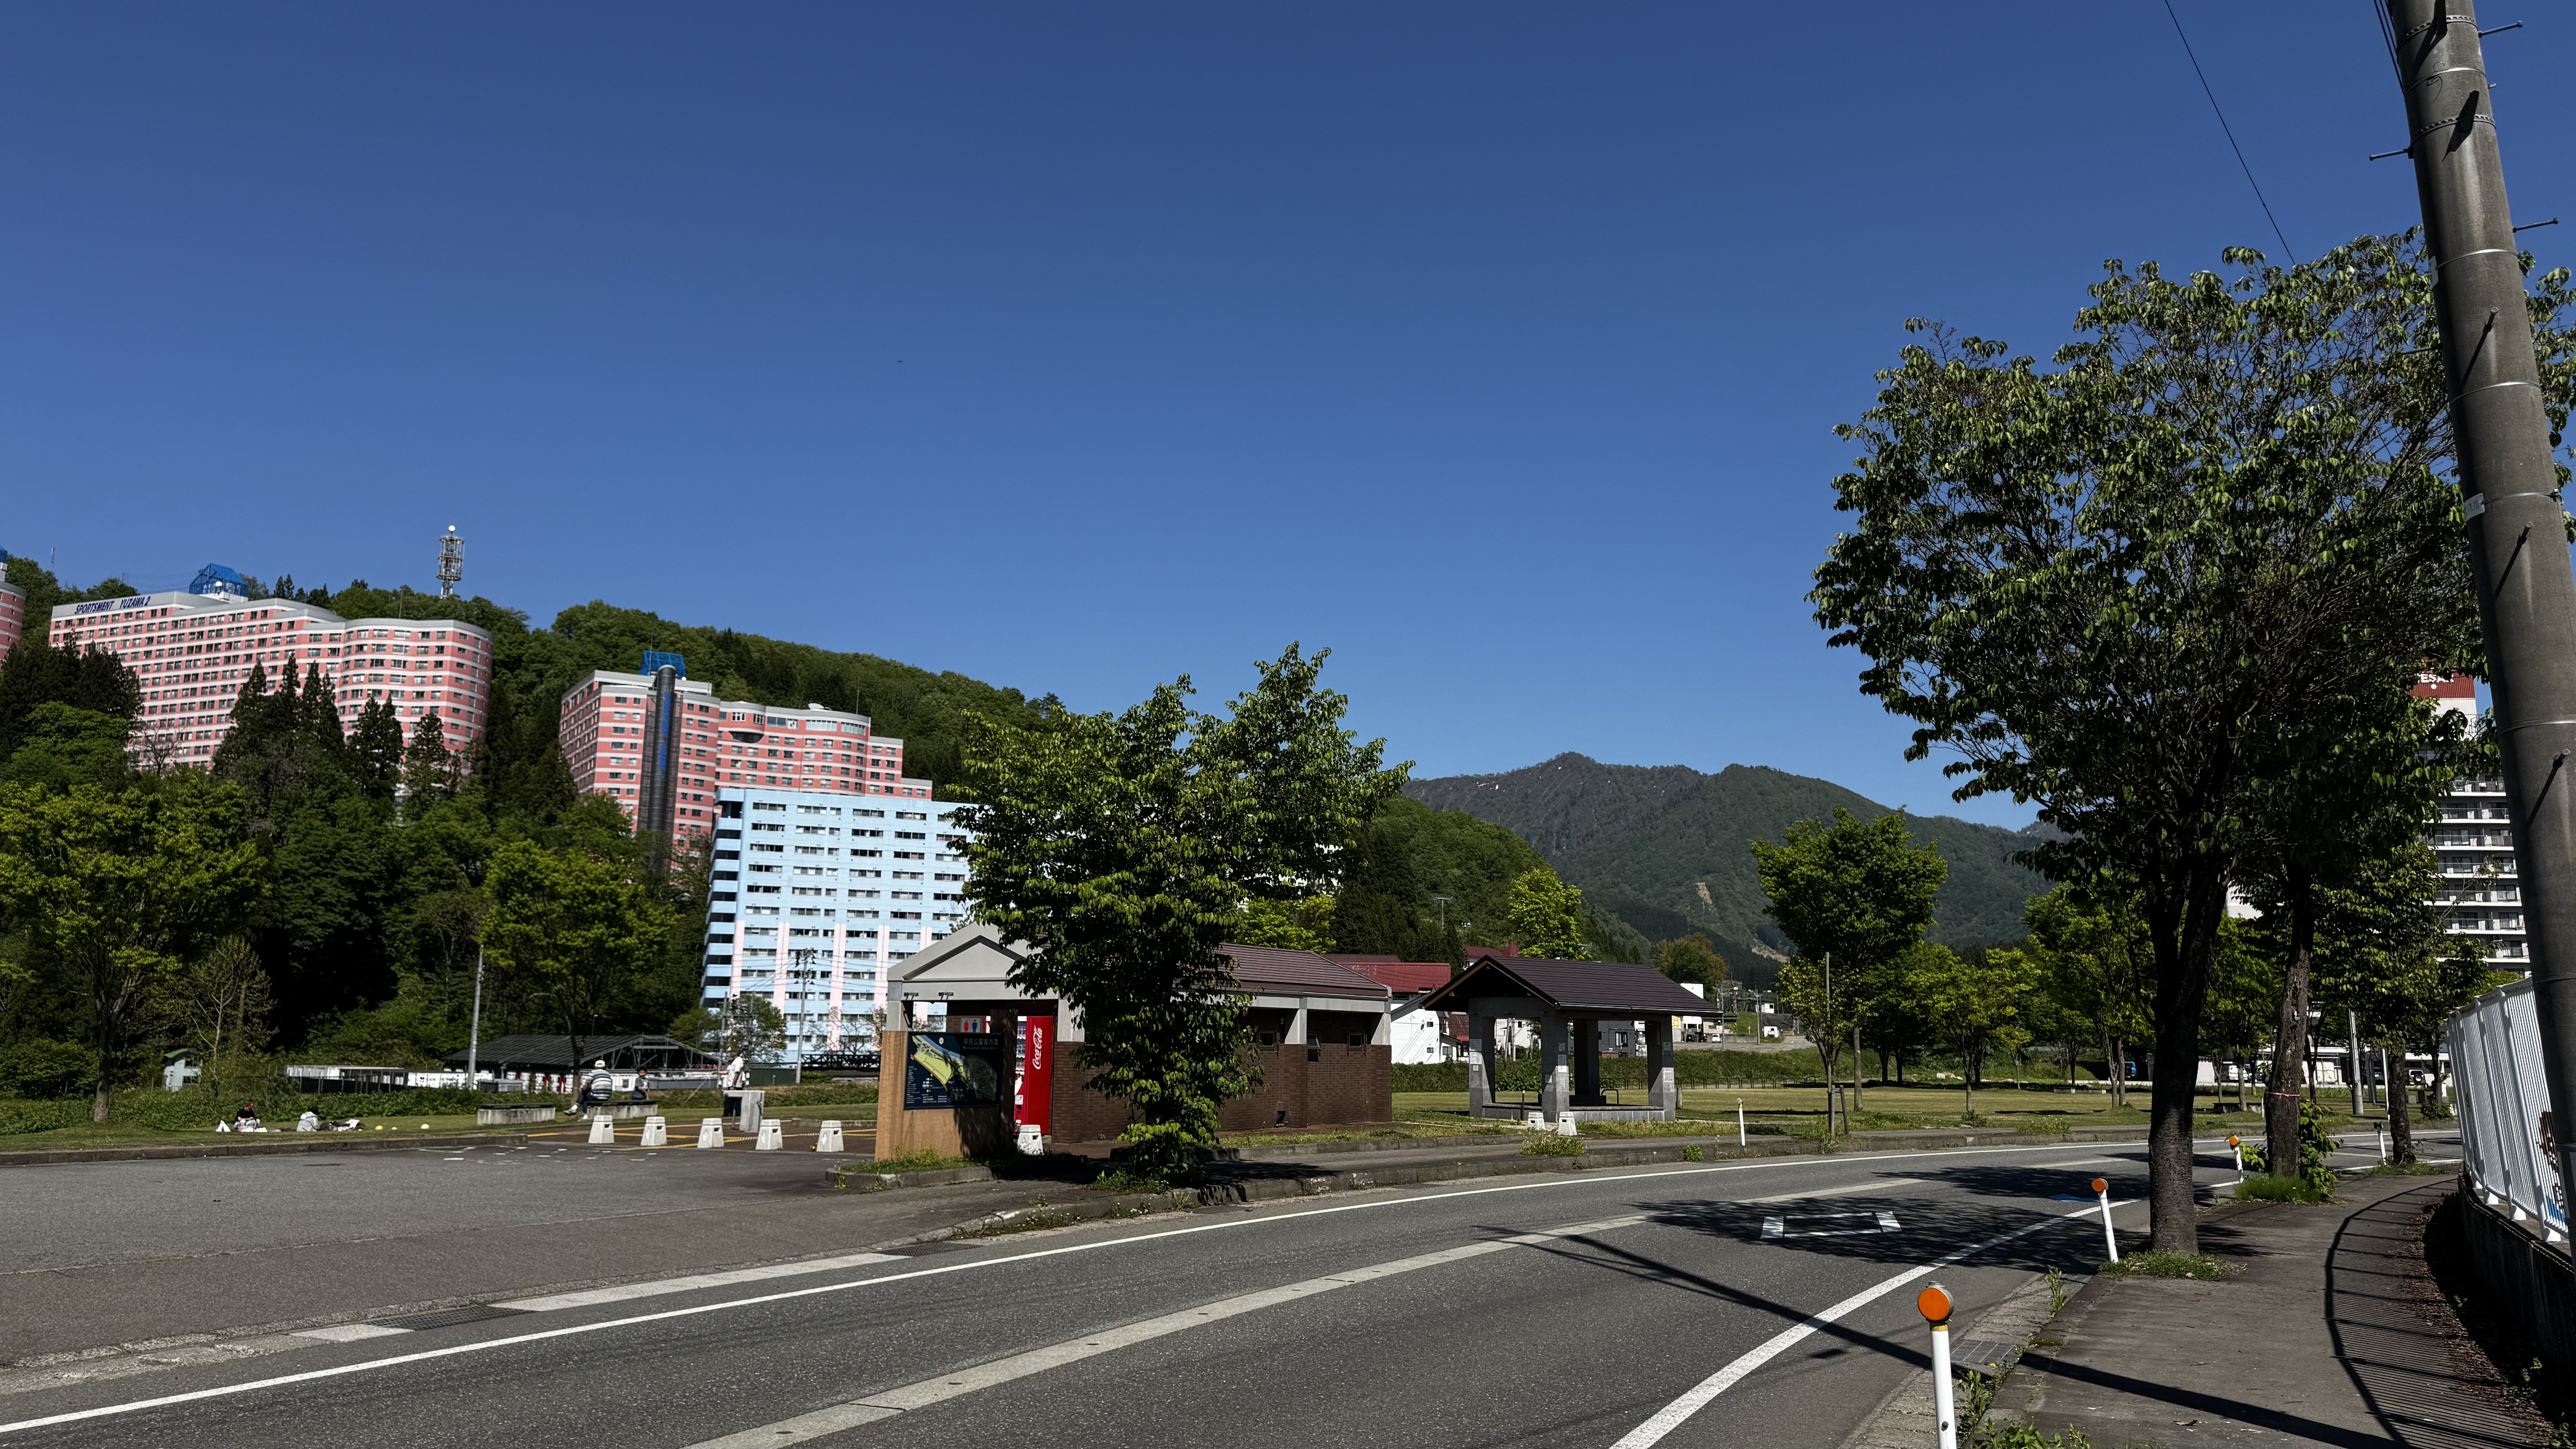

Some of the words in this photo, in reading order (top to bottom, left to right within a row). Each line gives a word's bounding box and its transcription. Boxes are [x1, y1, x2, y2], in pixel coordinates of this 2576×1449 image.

[75, 601, 115, 614] SPORTSMENT
[120, 597, 145, 609] YUZAWA
[144, 596, 151, 606] 2
